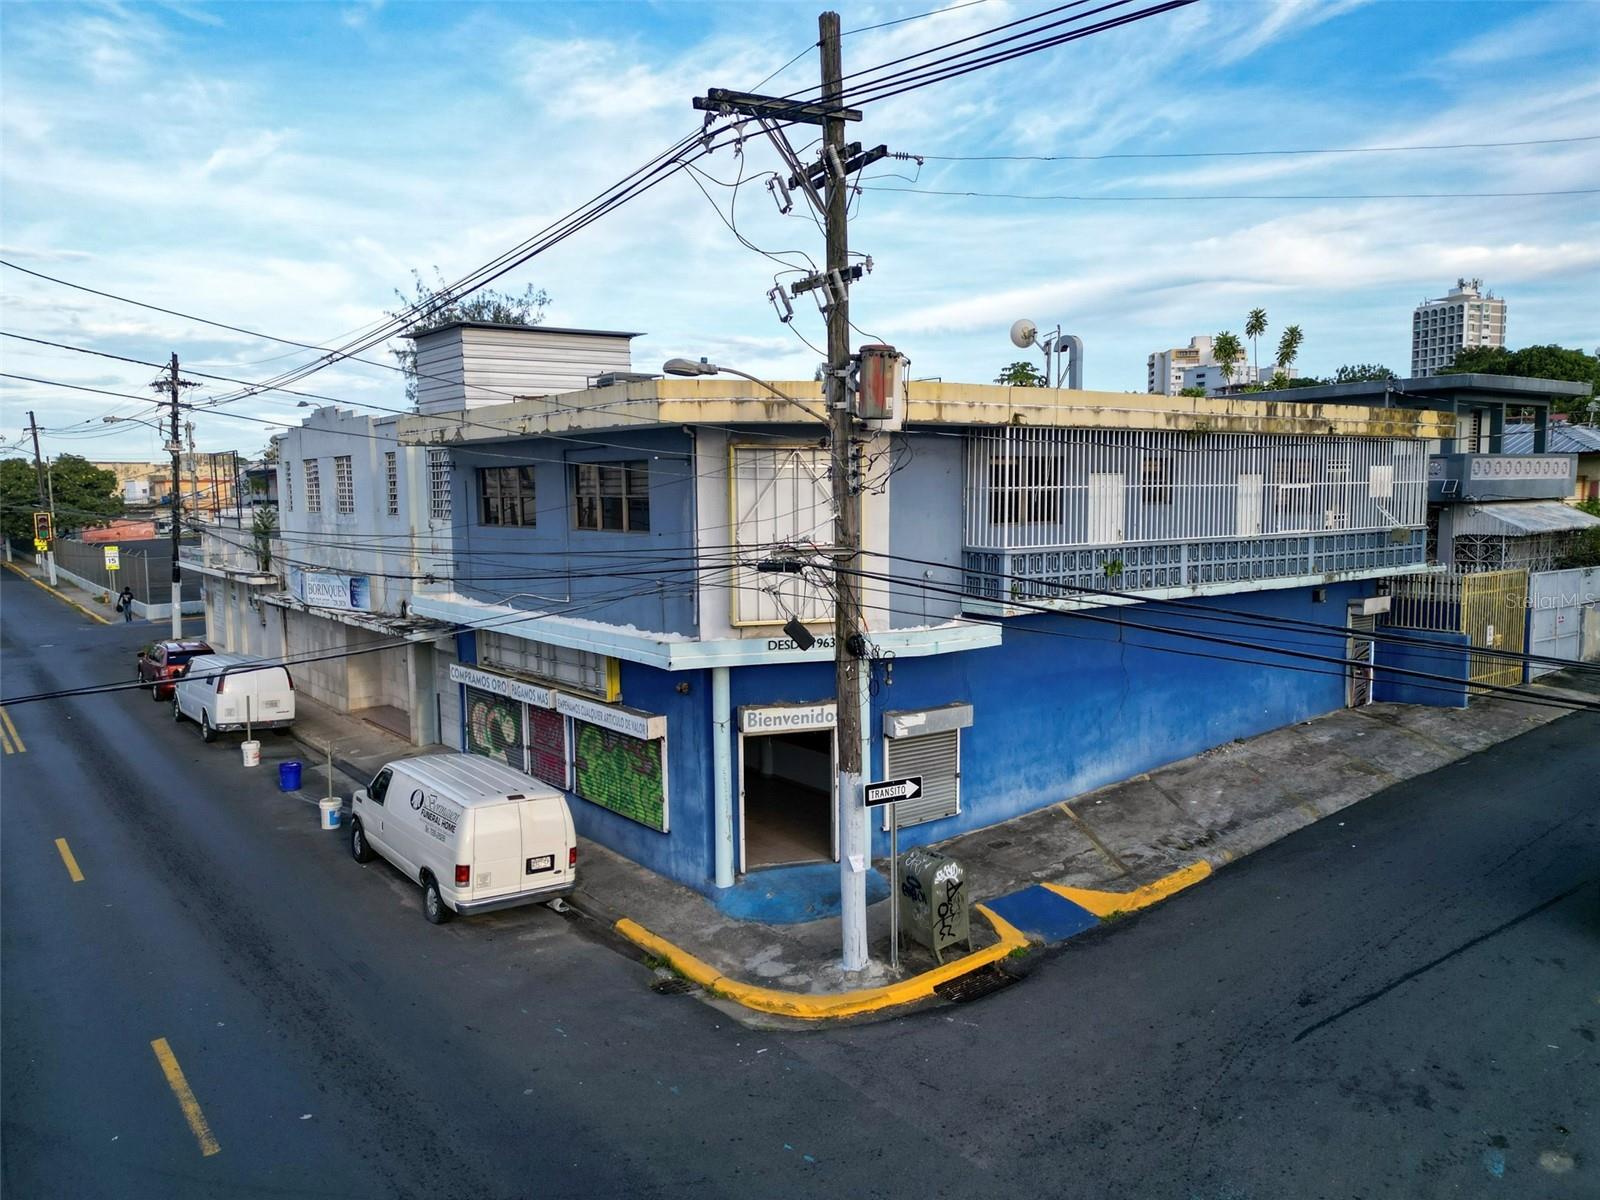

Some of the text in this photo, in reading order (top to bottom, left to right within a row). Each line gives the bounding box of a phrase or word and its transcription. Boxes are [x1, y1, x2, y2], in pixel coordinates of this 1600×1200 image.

[307, 583, 347, 599] BORINQUEN
[768, 640, 801, 651] DESD
[451, 666, 507, 694] COMPRAMOS ORO
[511, 683, 548, 706] PAGAMOS MAS
[747, 708, 837, 728] Bienvenido
[631, 720, 647, 736] VALOR
[870, 785, 906, 799] TRANSITO
[421, 808, 441, 826] FUNERAL
[441, 821, 457, 834] HOME
